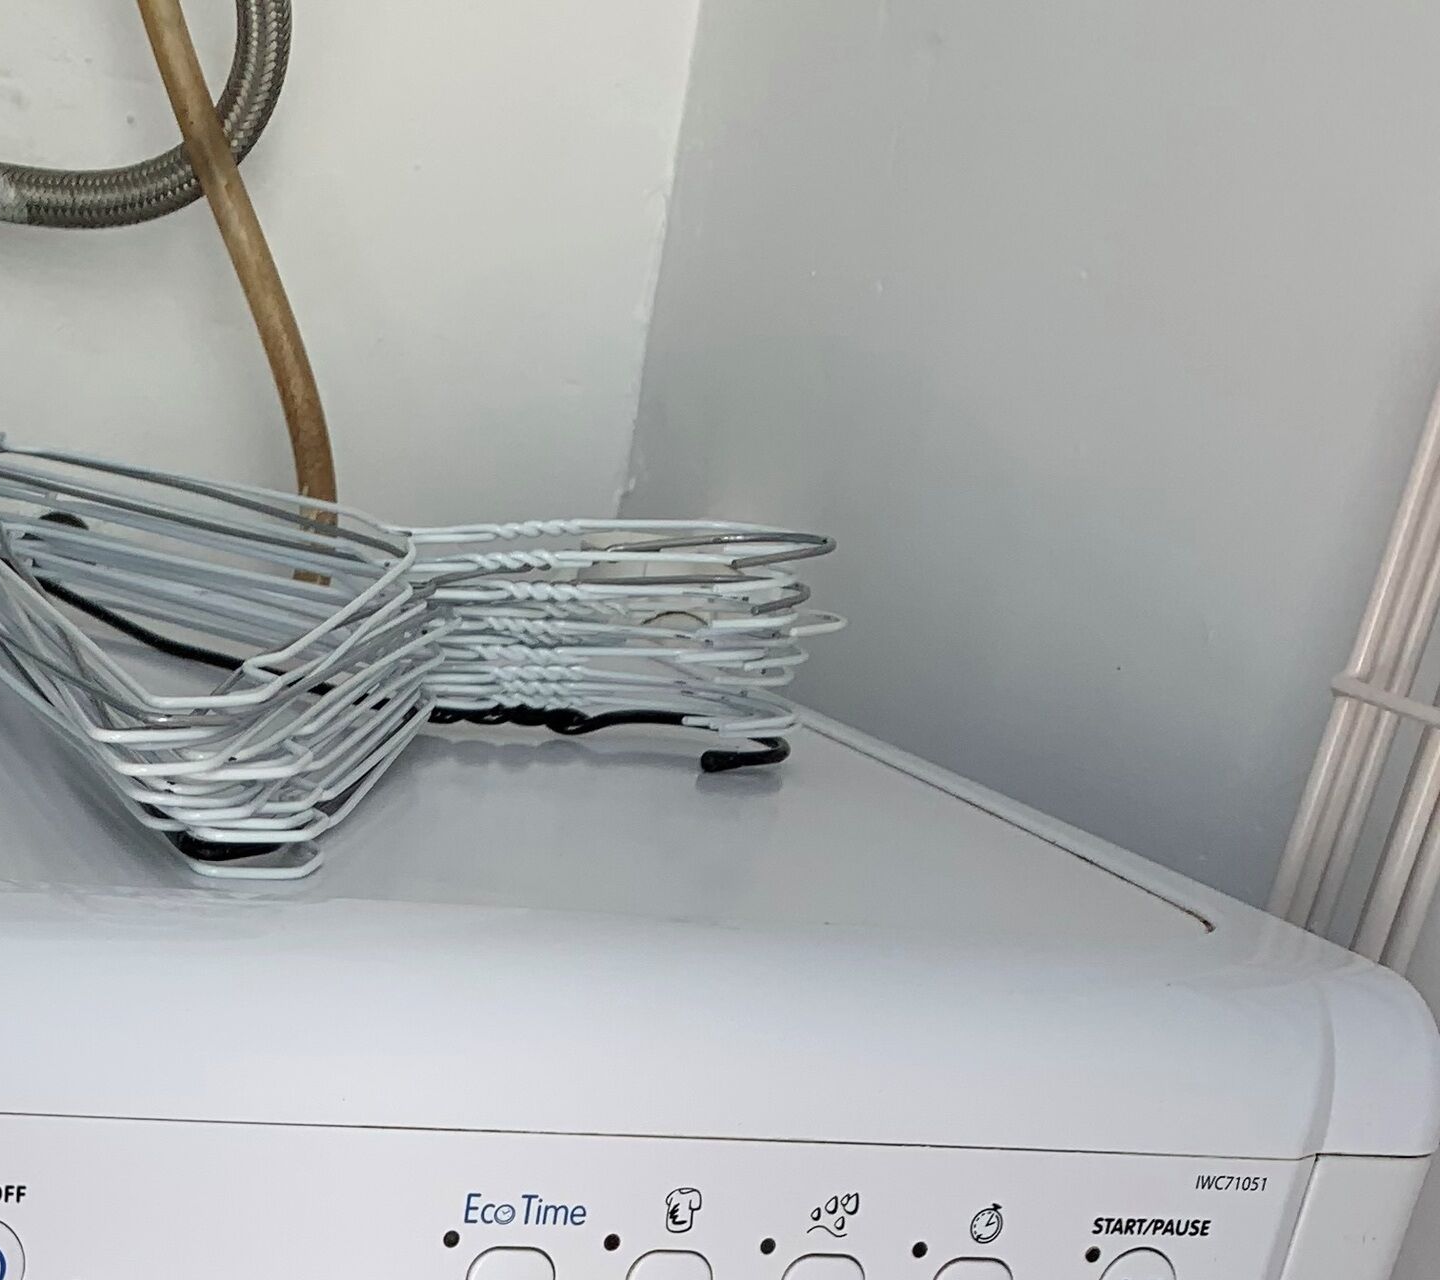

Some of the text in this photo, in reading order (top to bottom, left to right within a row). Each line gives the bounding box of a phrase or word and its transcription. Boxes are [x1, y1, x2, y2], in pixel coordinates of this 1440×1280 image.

[1195, 1175, 1268, 1191] IWC71051
[522, 1194, 587, 1225] Time
[1092, 1218, 1210, 1237] START/PAUSE
